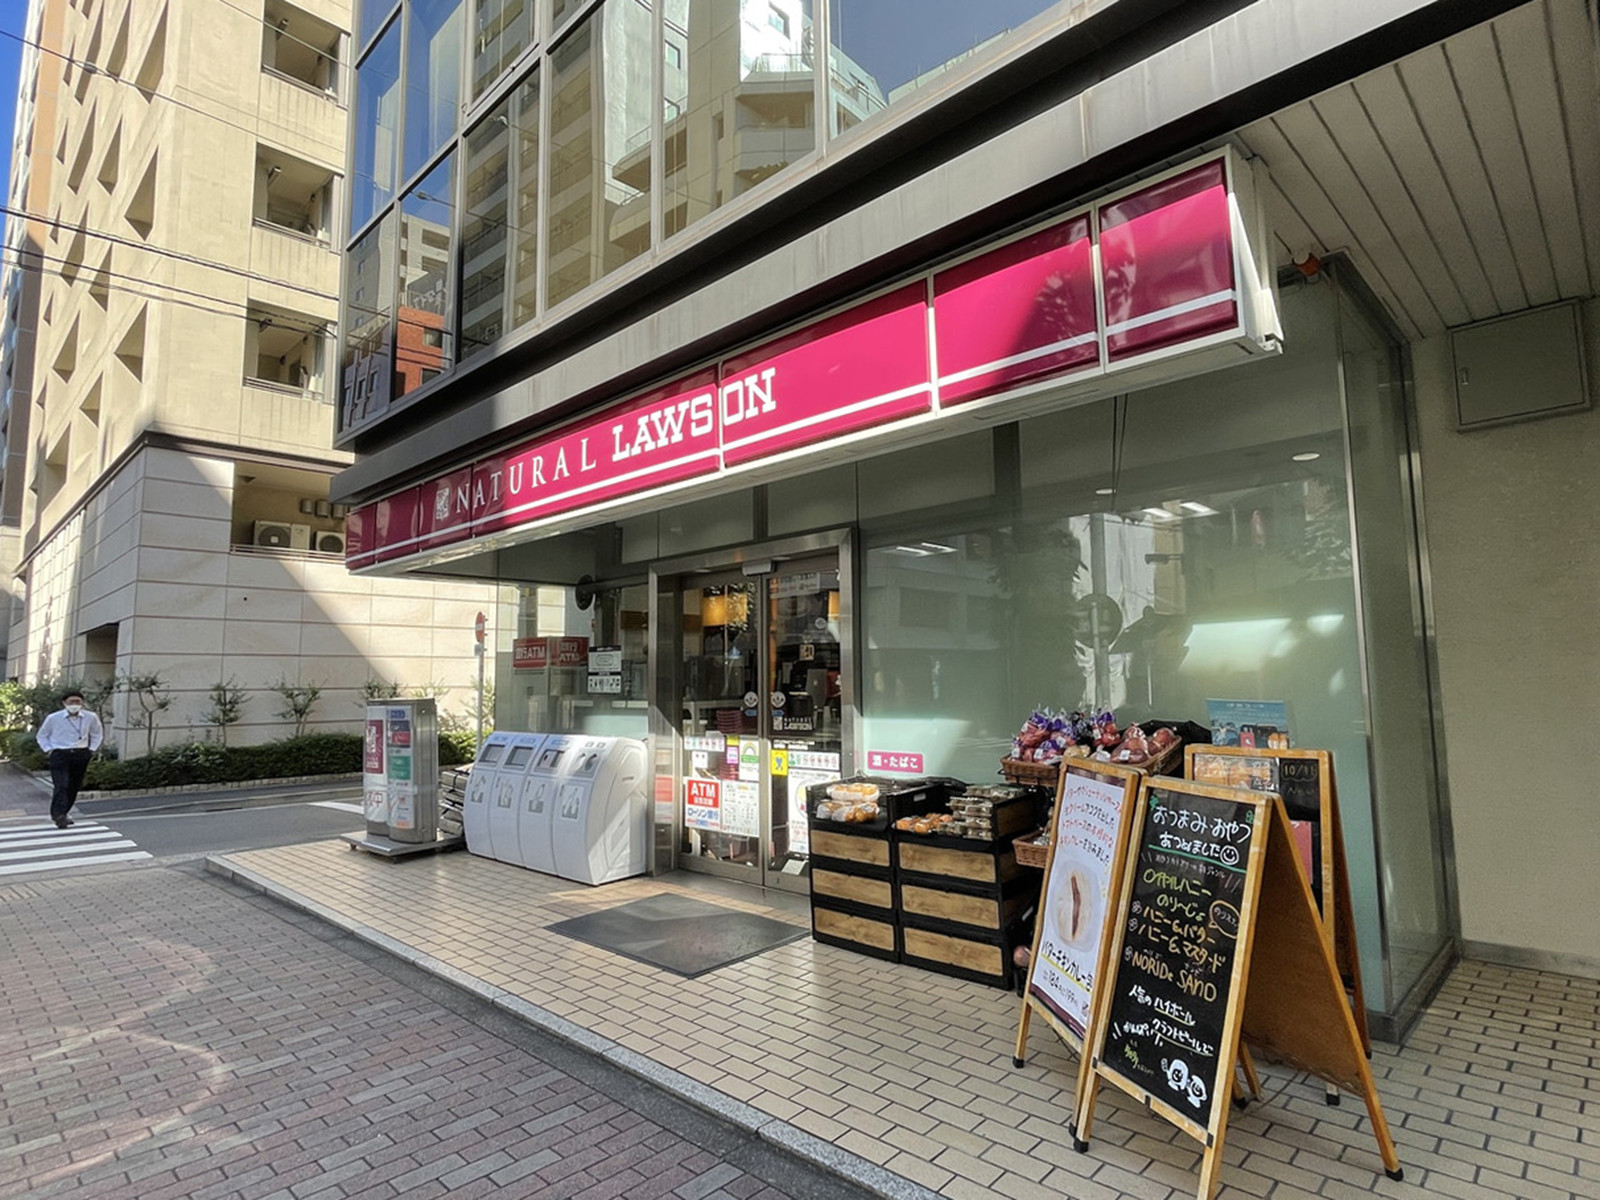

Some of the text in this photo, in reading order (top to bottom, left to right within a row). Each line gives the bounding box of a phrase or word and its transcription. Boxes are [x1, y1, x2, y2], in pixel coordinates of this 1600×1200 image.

[456, 367, 777, 513] NATURAL LAWSON
[690, 782, 716, 798] ATM
[1152, 804, 1252, 844] おつまみ・おやつ
[1159, 830, 1221, 858] あつめました
